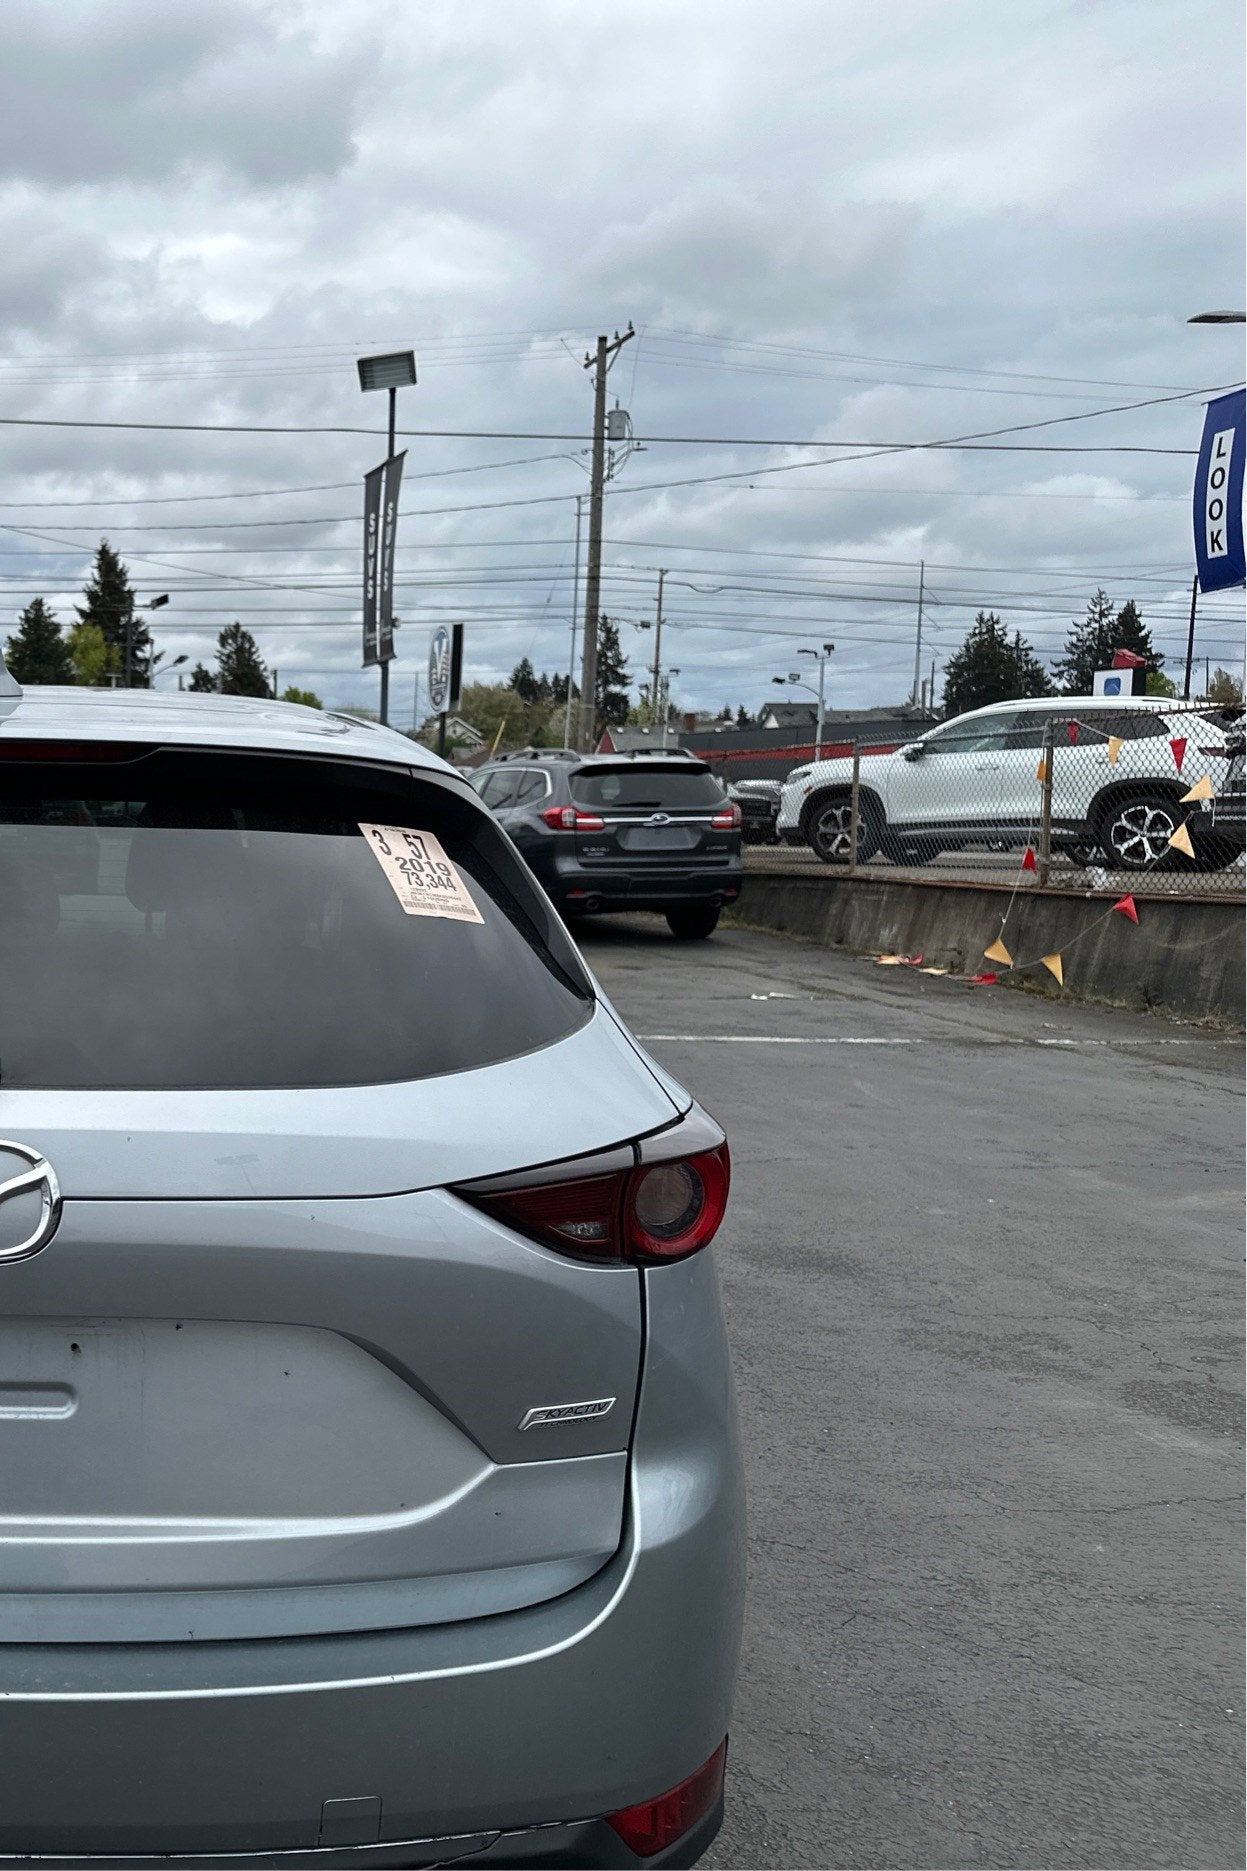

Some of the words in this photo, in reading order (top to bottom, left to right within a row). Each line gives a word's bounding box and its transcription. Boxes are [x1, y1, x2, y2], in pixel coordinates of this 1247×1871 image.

[1208, 436, 1227, 553] LOOK
[367, 512, 376, 600] SUVS
[372, 829, 392, 856] 3
[402, 833, 431, 861] 57
[395, 856, 452, 877] 2019
[401, 870, 457, 892] 73,344
[534, 1402, 609, 1421] SKYACTIV
